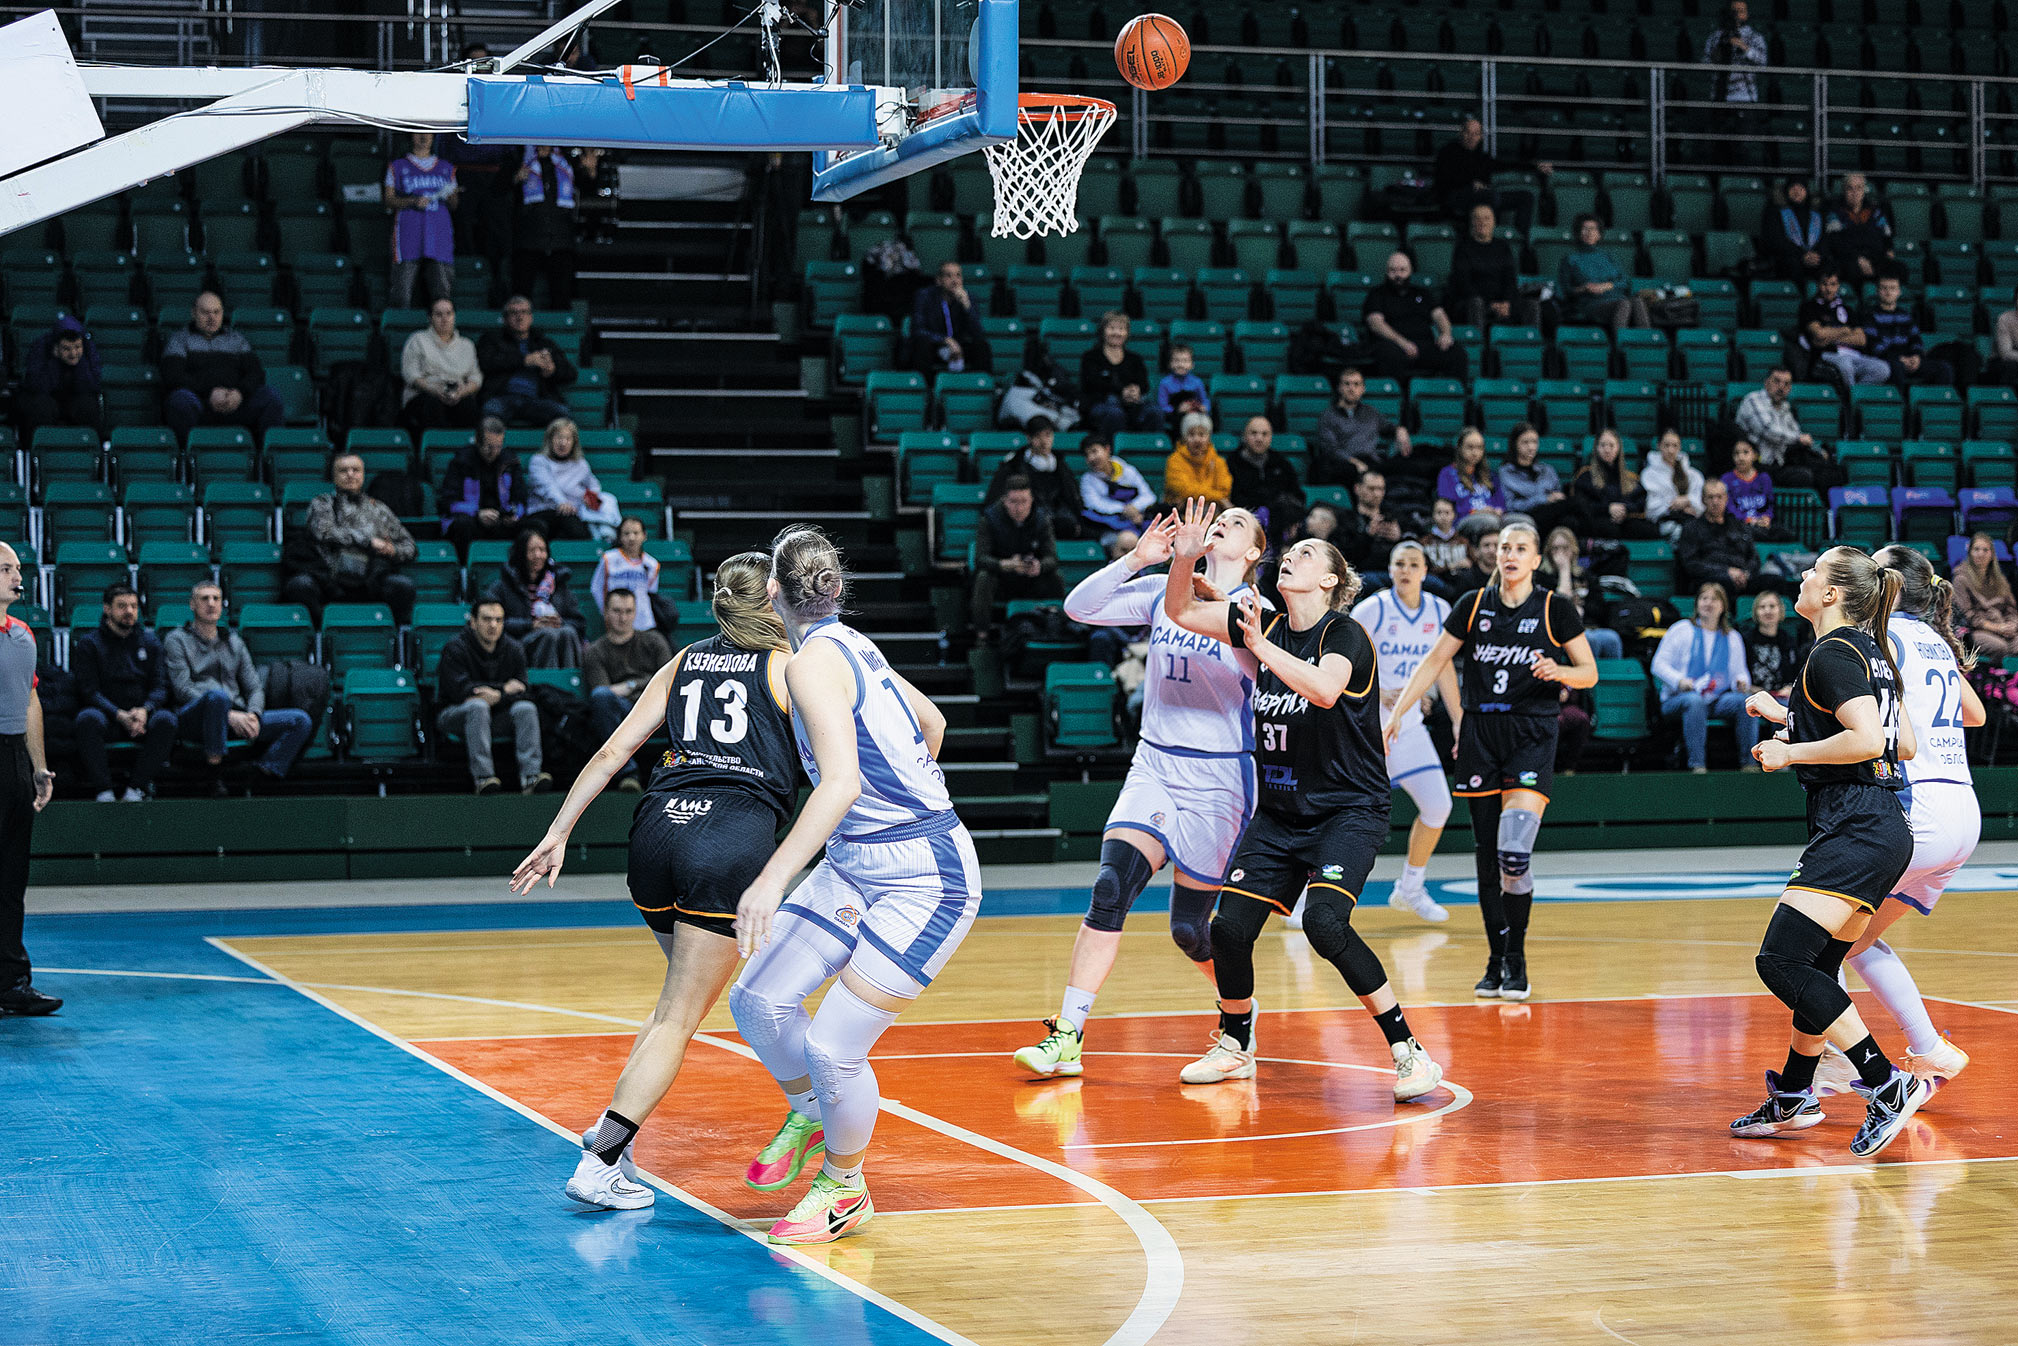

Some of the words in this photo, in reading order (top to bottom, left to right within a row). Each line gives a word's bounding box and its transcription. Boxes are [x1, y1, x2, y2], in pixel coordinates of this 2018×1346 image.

[1151, 625, 1222, 661] САМАРА
[1379, 641, 1432, 656] САМАР
[683, 652, 759, 673] КУЗНЕЦОВА
[1165, 653, 1192, 683] 11
[1492, 669, 1509, 694] 3
[679, 678, 749, 744] 13
[1925, 668, 1963, 728] 22
[1262, 722, 1288, 752] 37
[729, 765, 764, 778] ОБЛАСТИ
[1262, 764, 1299, 785] TDL
